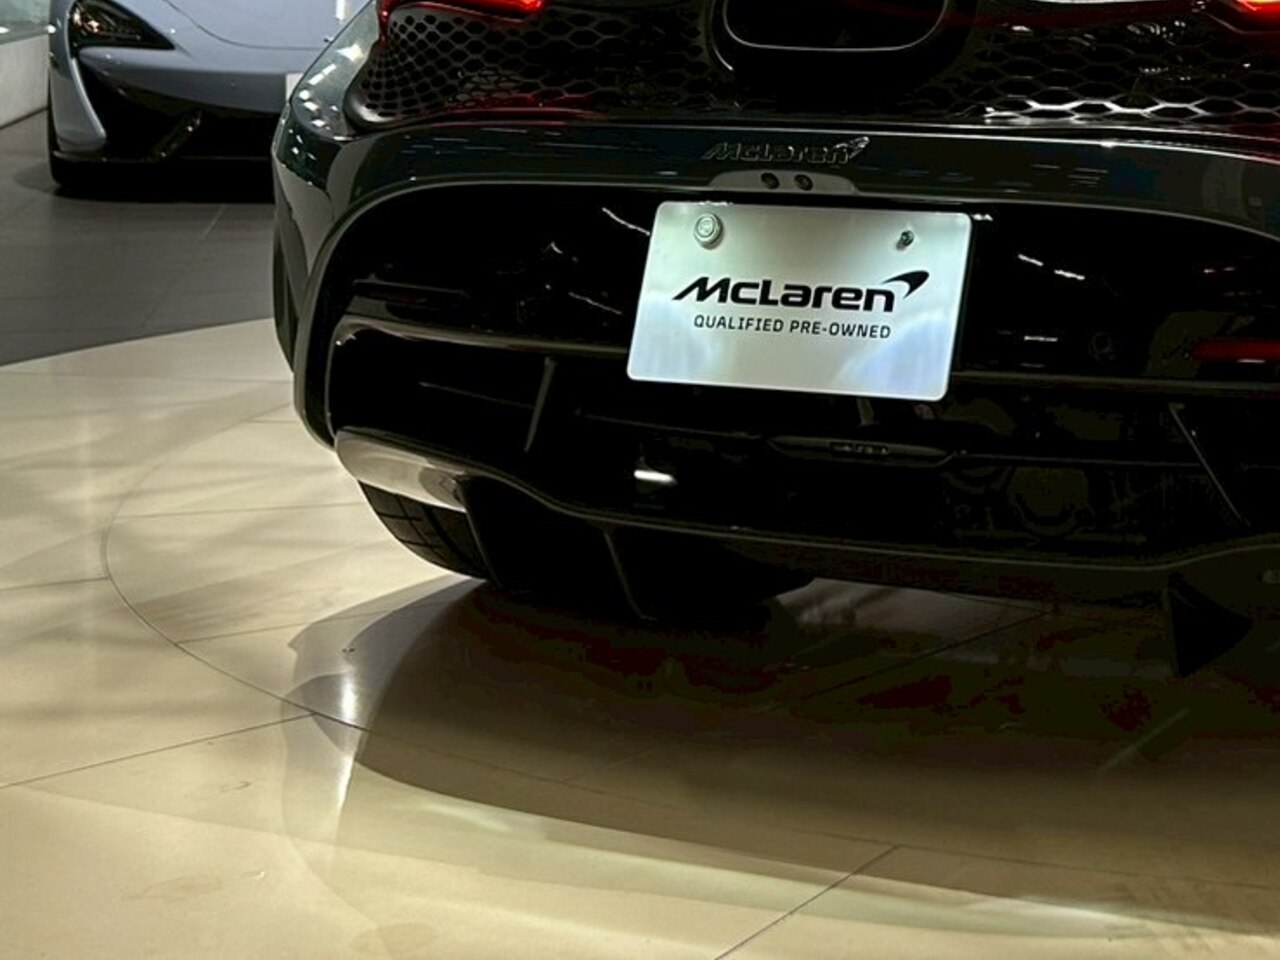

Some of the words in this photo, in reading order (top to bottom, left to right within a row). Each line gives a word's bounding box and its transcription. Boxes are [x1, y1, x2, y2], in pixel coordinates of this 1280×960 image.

[701, 141, 849, 165] McLaren
[672, 276, 896, 313] McLaren
[693, 314, 784, 333] QUALIFIED
[789, 320, 892, 339] PRE-OWNED
